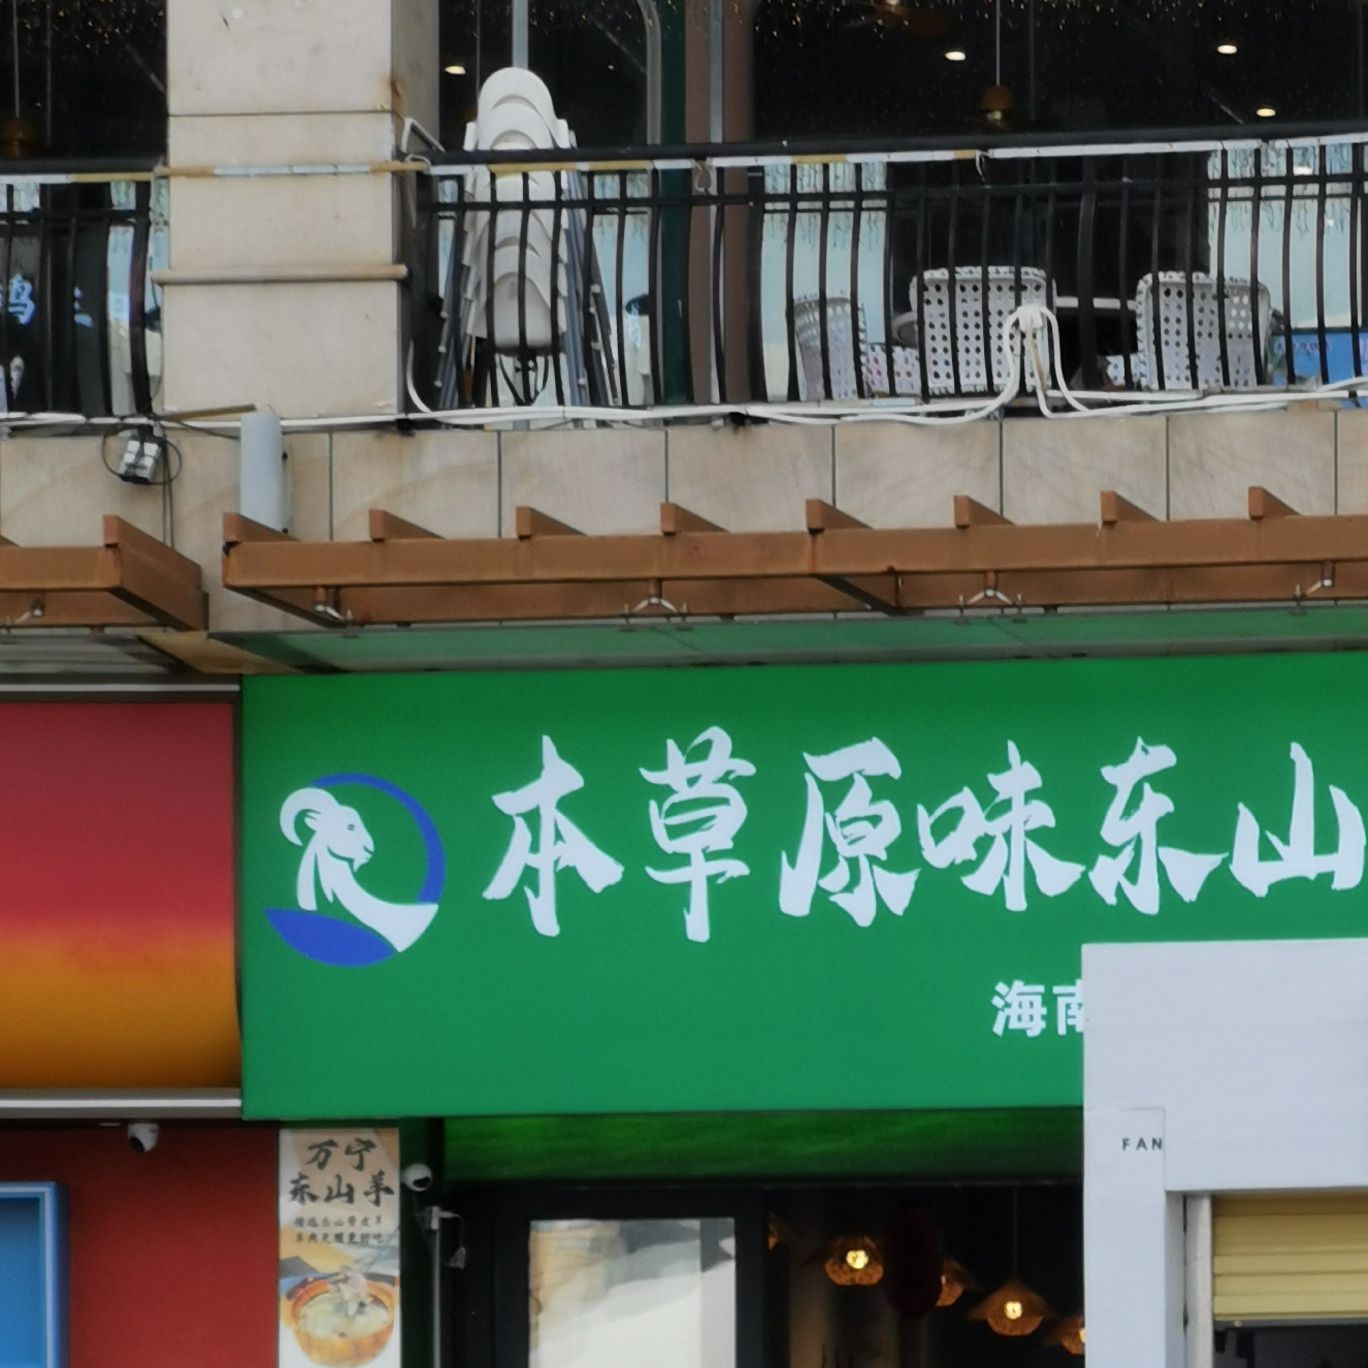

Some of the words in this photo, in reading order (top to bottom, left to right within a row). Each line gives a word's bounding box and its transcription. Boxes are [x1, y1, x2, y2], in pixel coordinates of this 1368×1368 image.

[305, 1137, 378, 1172] 万宁
[1121, 1137, 1164, 1152] FAN
[289, 1169, 395, 1208] 东山羊
